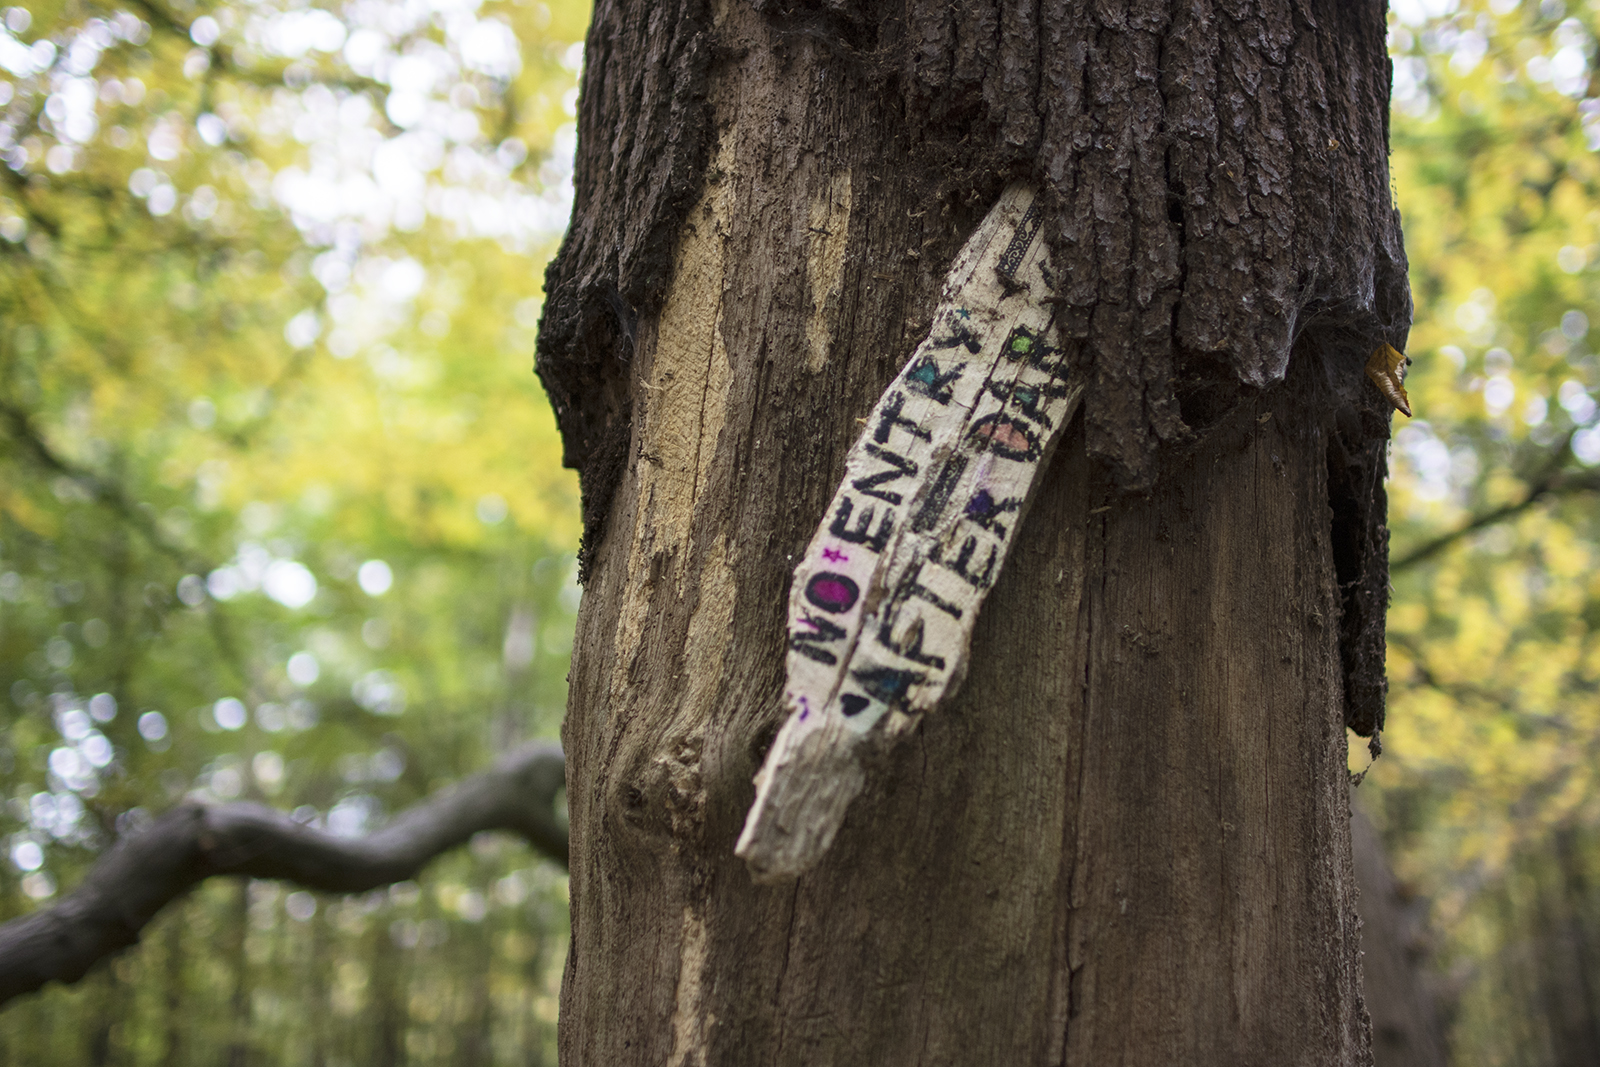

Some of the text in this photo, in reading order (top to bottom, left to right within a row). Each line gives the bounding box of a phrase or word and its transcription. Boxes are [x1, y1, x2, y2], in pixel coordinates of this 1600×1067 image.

[788, 309, 983, 666] NO ENTRY
[850, 258, 1069, 713] AFTER DAR
